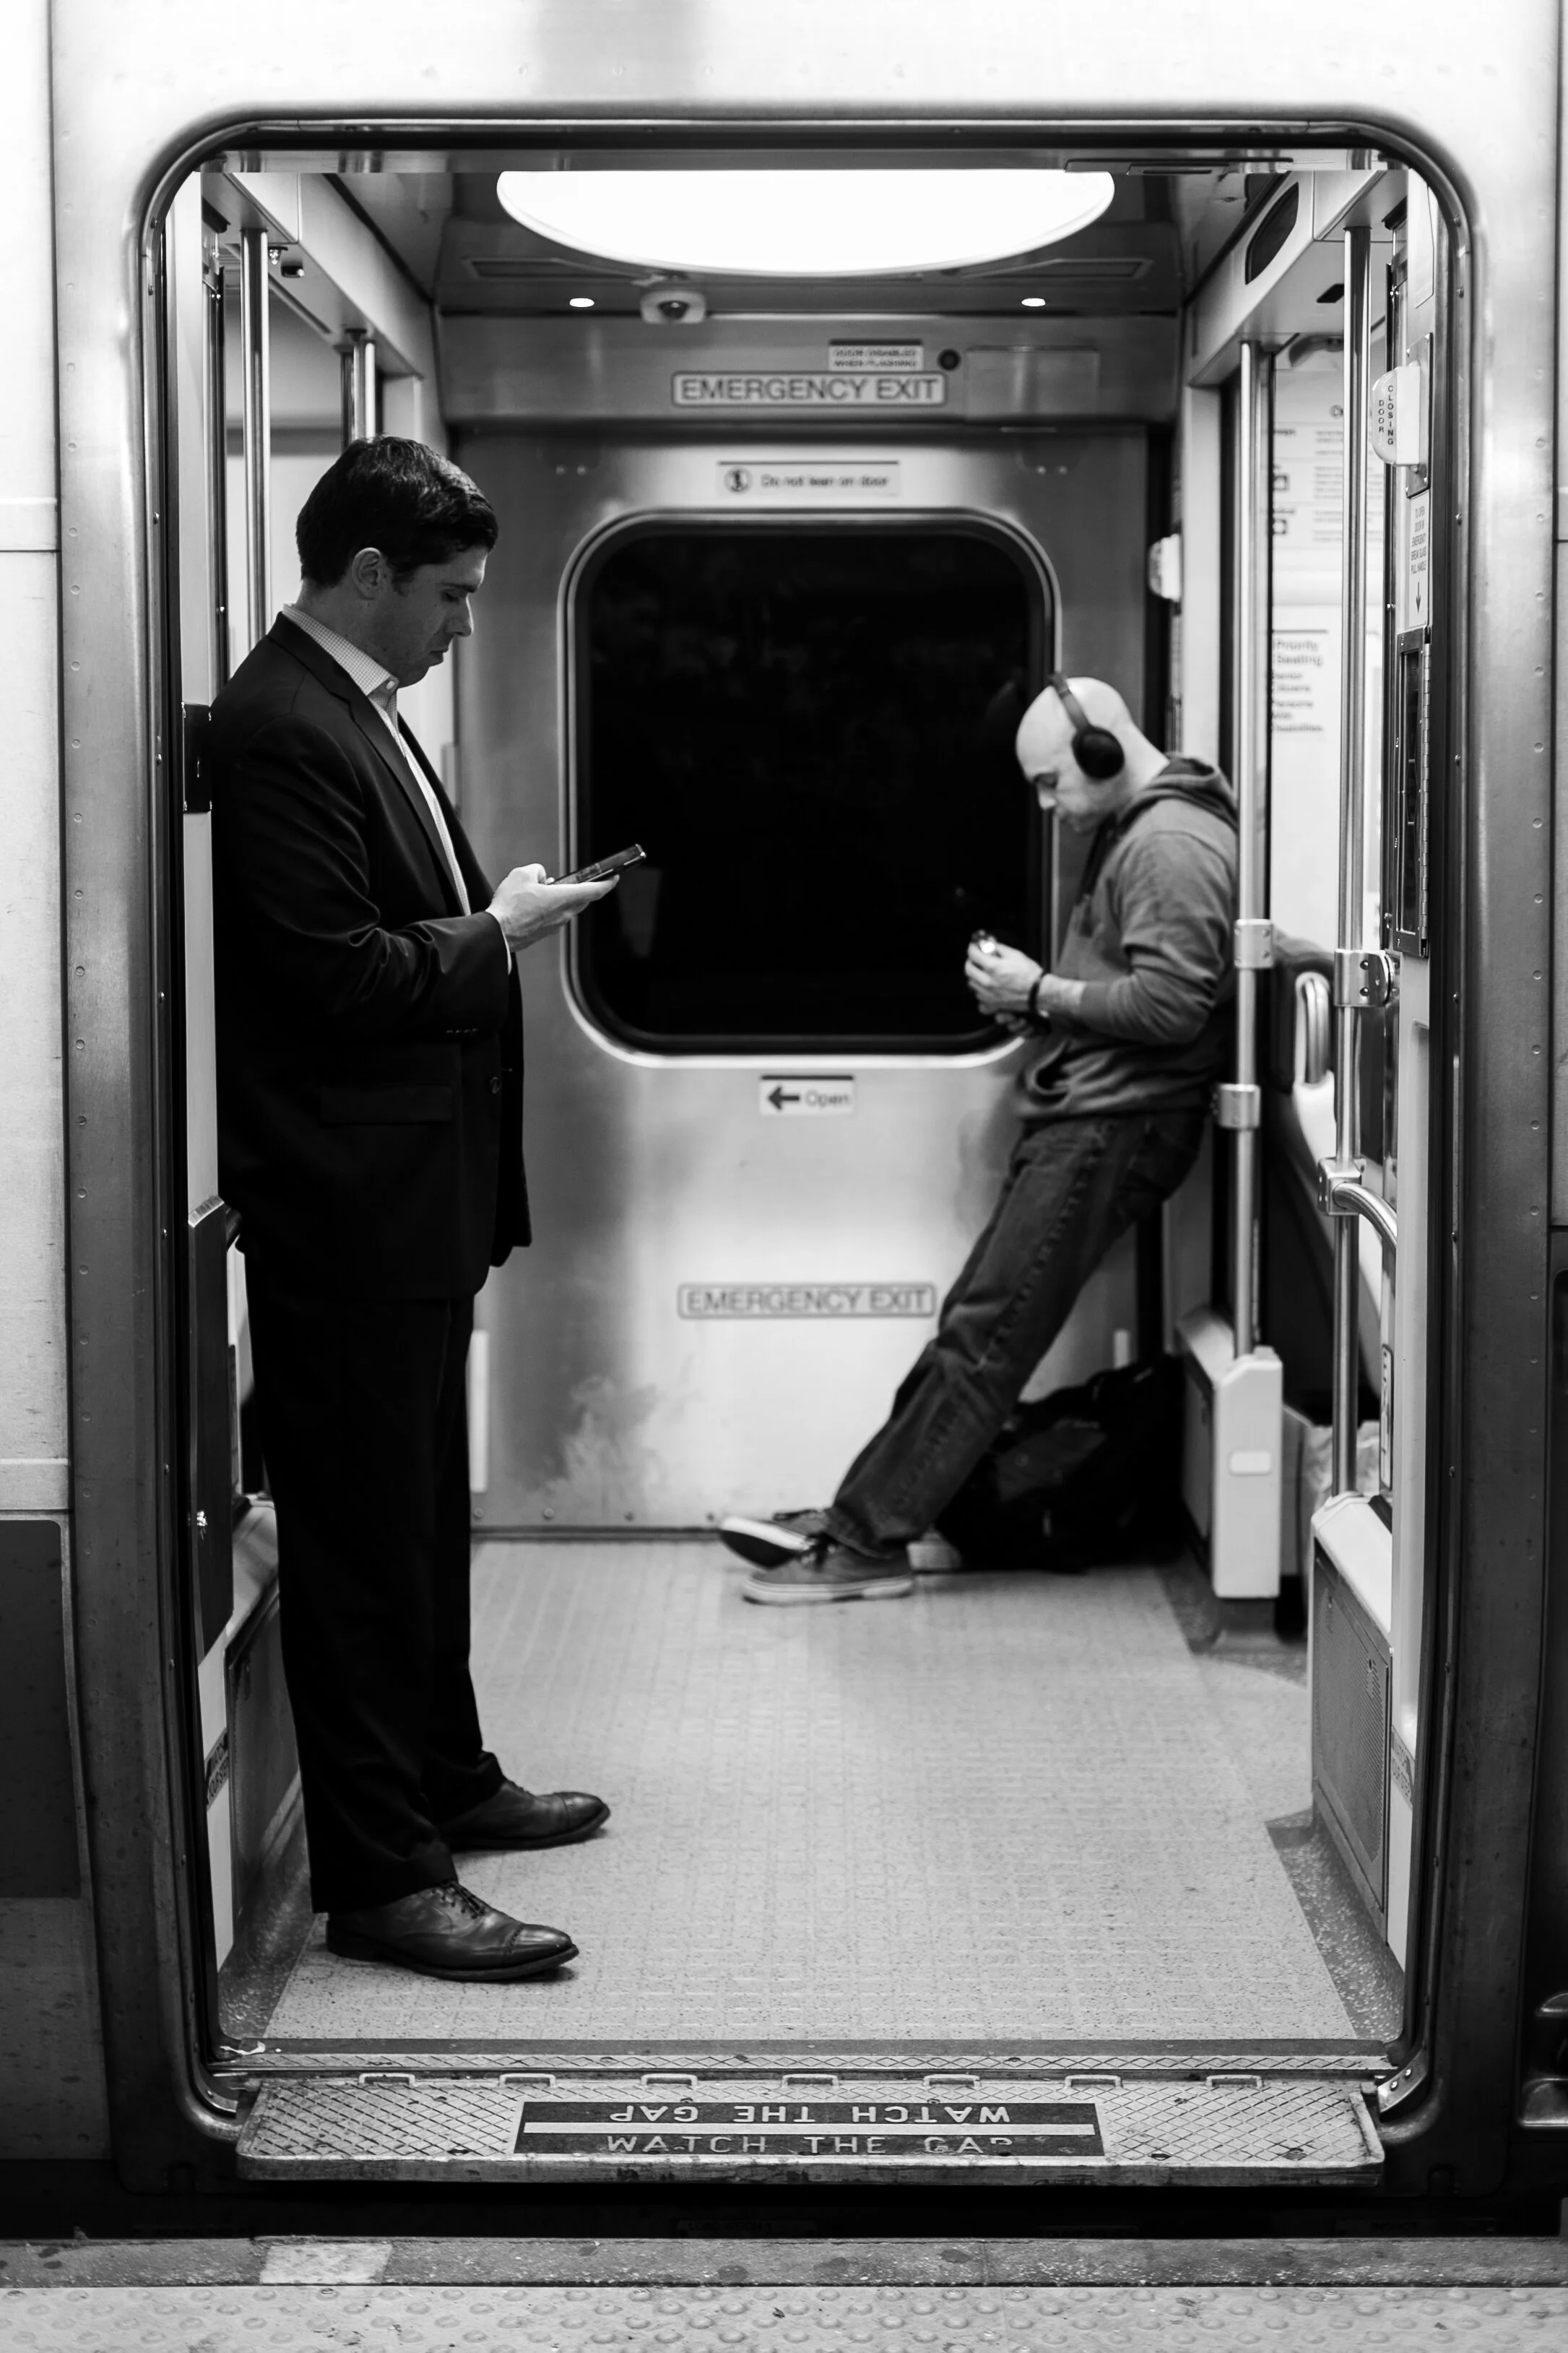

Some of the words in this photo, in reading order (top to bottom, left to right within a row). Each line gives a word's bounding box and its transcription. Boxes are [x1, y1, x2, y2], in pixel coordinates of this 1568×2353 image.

[682, 378, 866, 400] EMERGENCY
[876, 378, 940, 400] EXIT
[1412, 532, 1426, 547] EMERGENCY
[1417, 560, 1426, 572] HANDLE
[1277, 639, 1318, 652] Priority
[1277, 654, 1323, 666] Seating
[806, 1089, 850, 1109] Open
[687, 1290, 862, 1313] EMERGENCY
[869, 1290, 928, 1312] EXIT
[610, 2105, 699, 2123] GAP
[733, 2105, 815, 2123] THE
[852, 2106, 1010, 2123] WATCH
[607, 2136, 766, 2153] WATCH
[803, 2136, 887, 2154] THE
